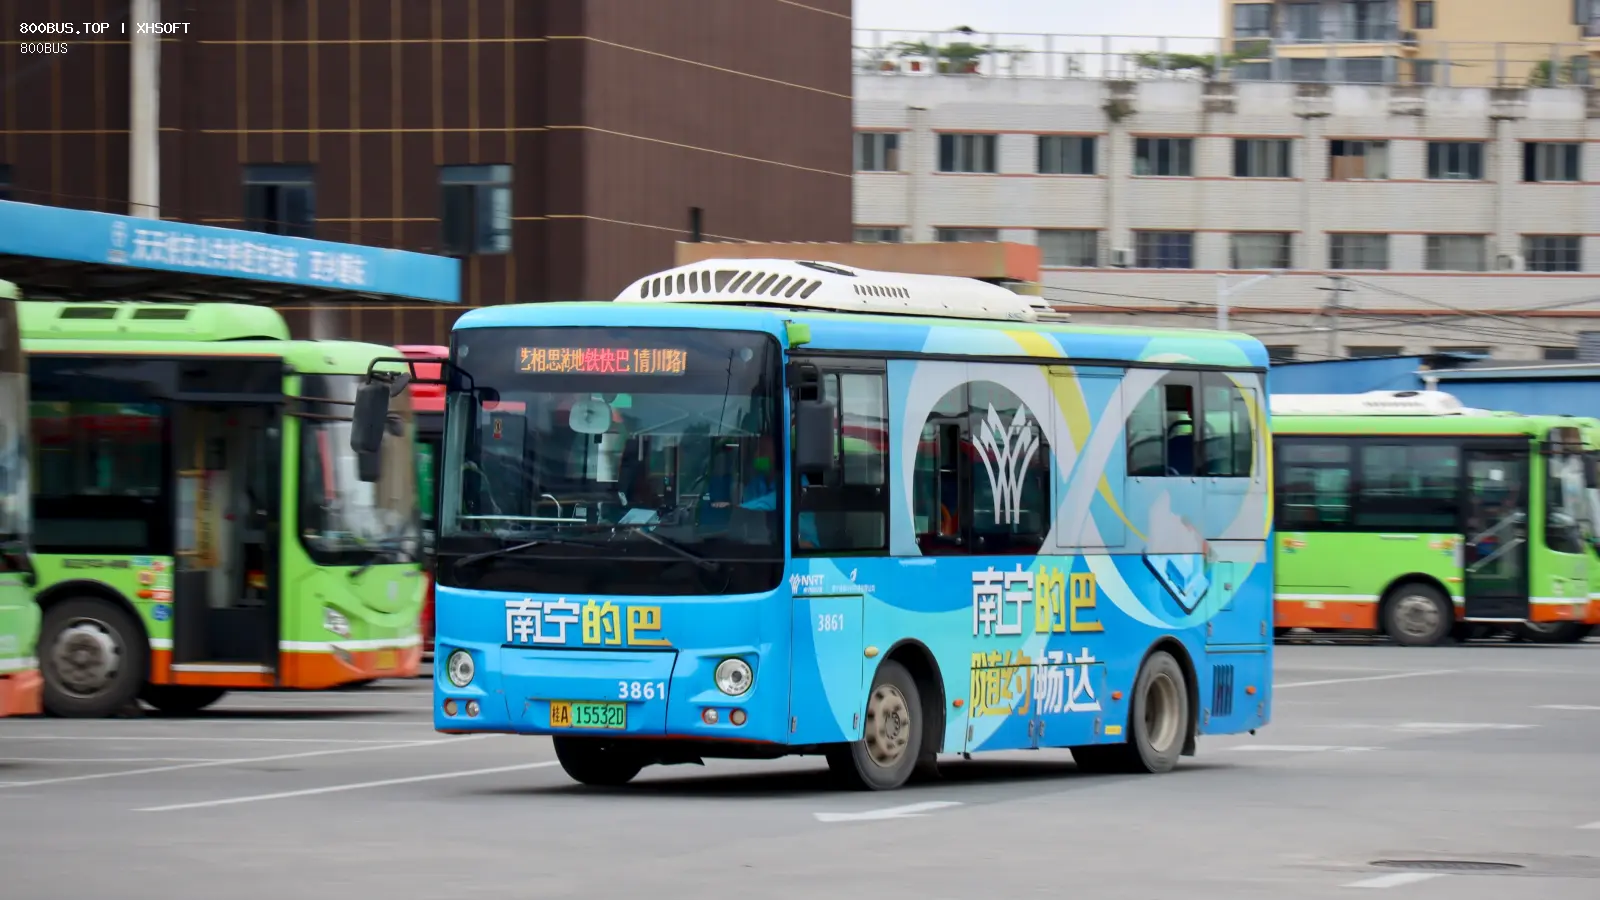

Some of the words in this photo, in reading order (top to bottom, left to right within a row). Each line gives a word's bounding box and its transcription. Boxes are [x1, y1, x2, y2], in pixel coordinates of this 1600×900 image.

[971, 563, 1105, 636] 南宁的巴
[505, 597, 672, 646] 南宁的巴
[818, 614, 843, 631] 3861
[617, 681, 666, 700] 3861
[969, 647, 1101, 718] 随约畅达
[576, 706, 624, 724] 15532D
